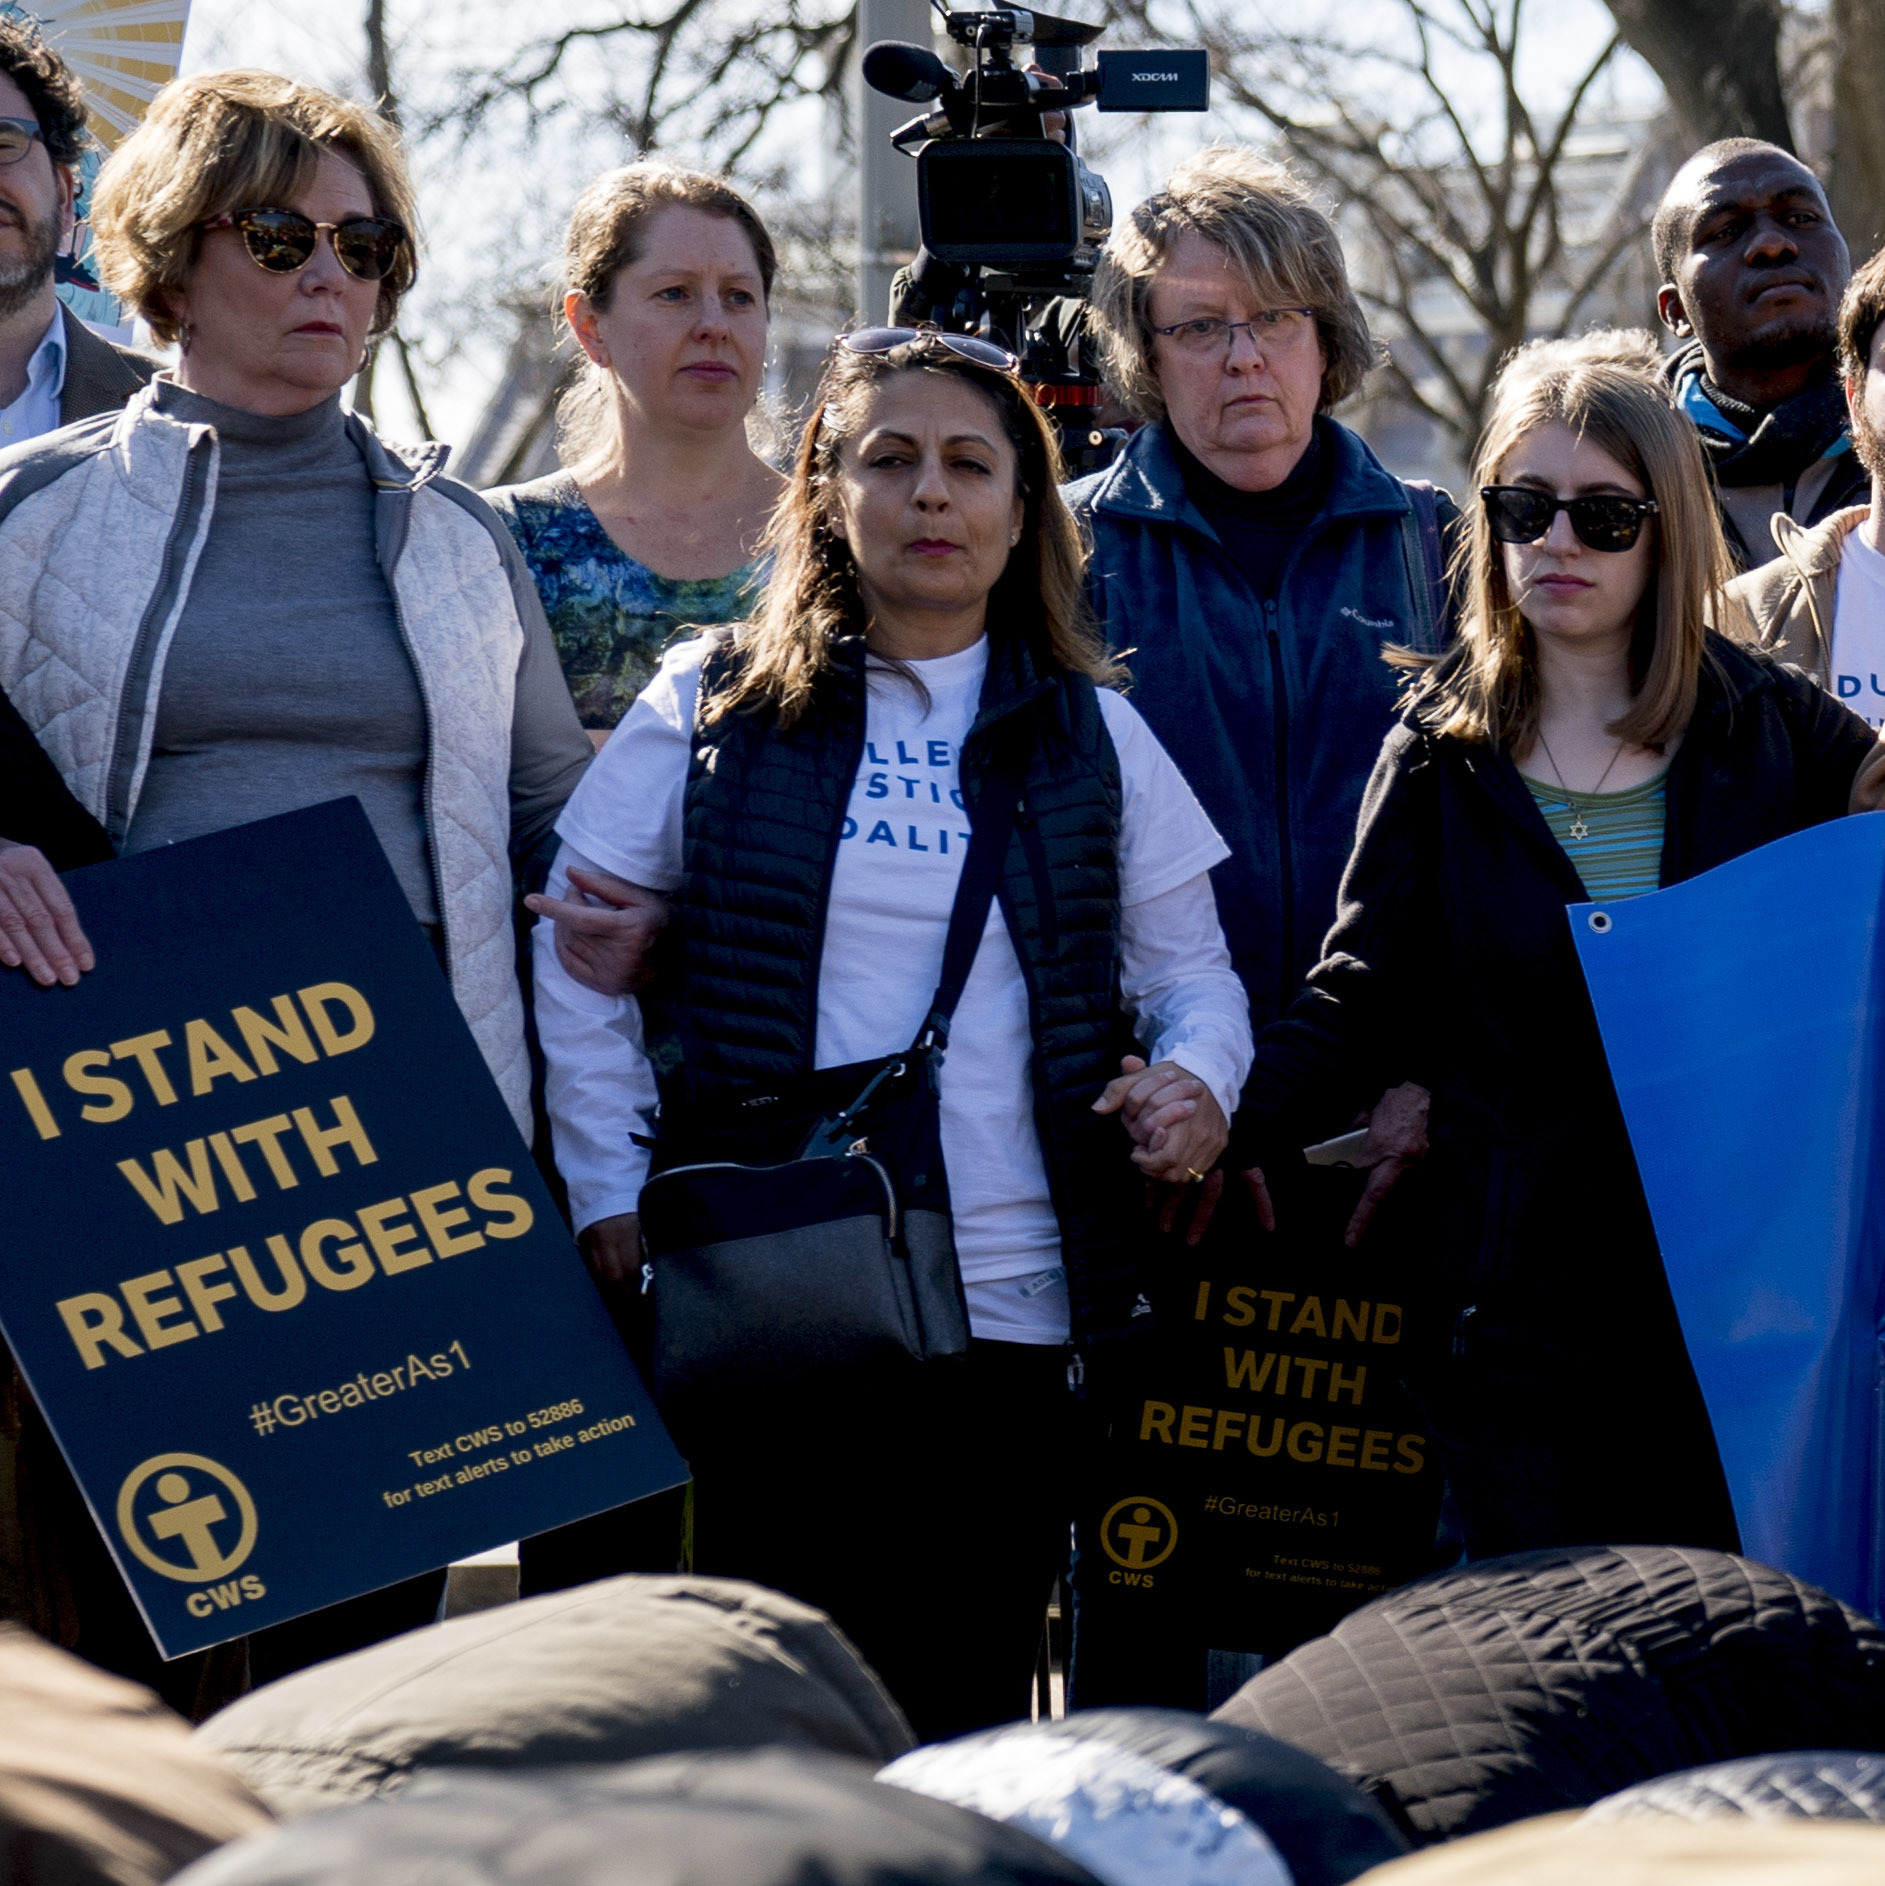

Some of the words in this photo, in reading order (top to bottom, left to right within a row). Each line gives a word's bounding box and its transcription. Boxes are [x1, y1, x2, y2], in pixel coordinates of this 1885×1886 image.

[1132, 73, 1179, 82] XDCAM
[12, 1068, 60, 1139] I
[62, 982, 376, 1125] STAND
[118, 1095, 379, 1226] WITH
[56, 1168, 534, 1369] REFUGEES
[1195, 1281, 1210, 1320] I
[1223, 1287, 1402, 1344] STAND
[249, 1340, 472, 1434] #GreaterAs1
[1223, 1347, 1366, 1404] WITH
[382, 1489, 412, 1508] for
[414, 1474, 455, 1498] text
[455, 1457, 509, 1485] alerts
[510, 1449, 533, 1466] to
[533, 1436, 576, 1458] take
[577, 1413, 637, 1443] action
[408, 1441, 455, 1468] Text
[455, 1425, 503, 1453] CWS
[504, 1420, 526, 1437] to
[526, 1398, 585, 1428] 52886
[1140, 1400, 1425, 1474] REFUGEES
[1204, 1496, 1339, 1527] #GreaterAs1
[186, 1575, 266, 1617] CWS
[1109, 1570, 1154, 1588] CWS
